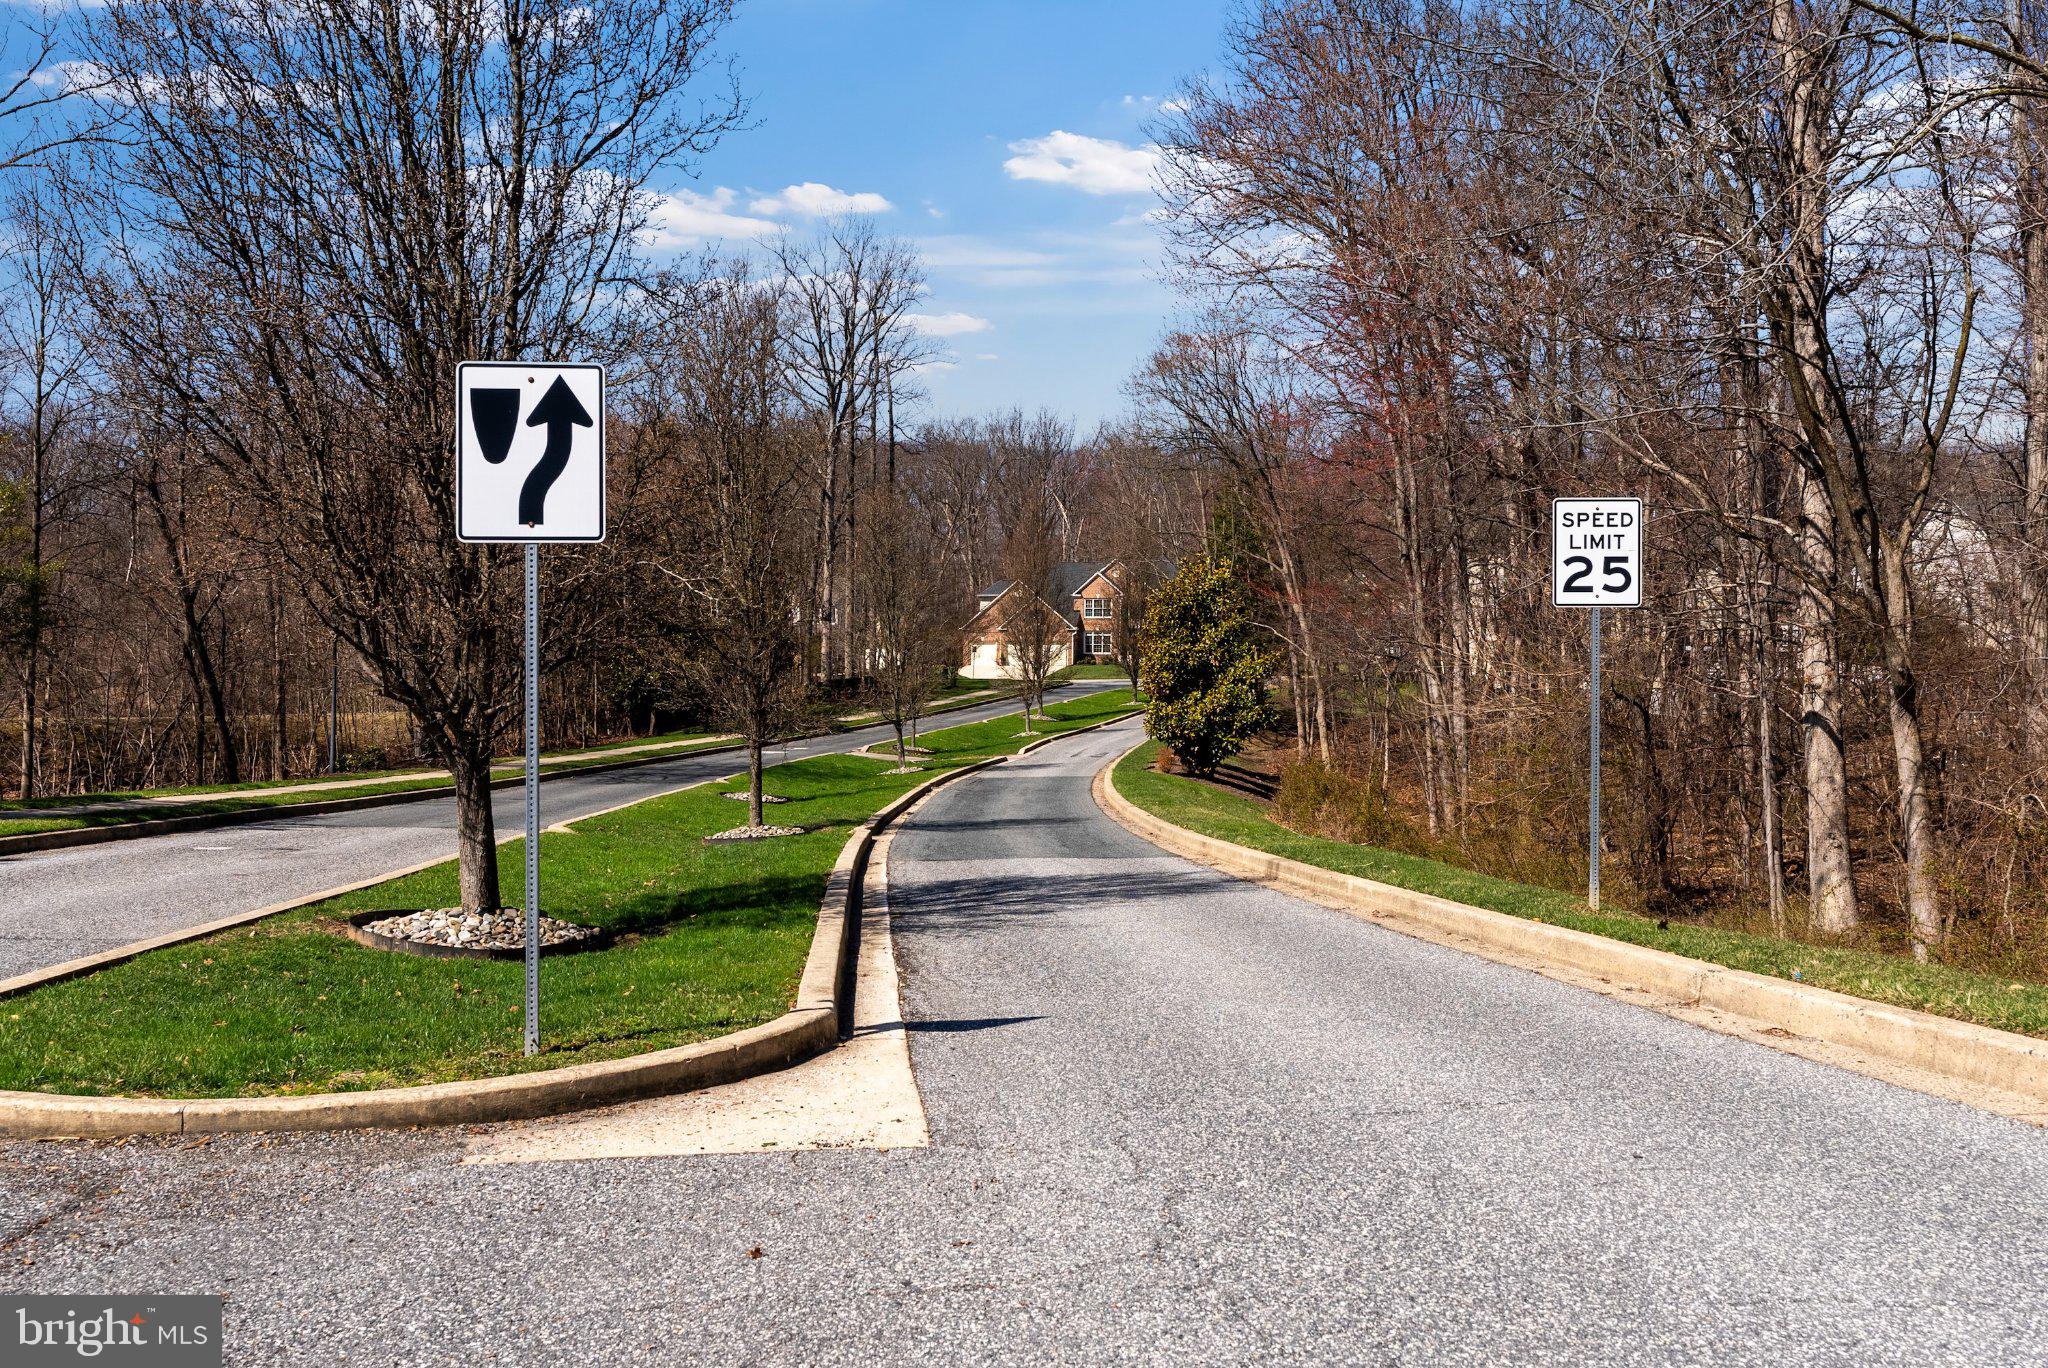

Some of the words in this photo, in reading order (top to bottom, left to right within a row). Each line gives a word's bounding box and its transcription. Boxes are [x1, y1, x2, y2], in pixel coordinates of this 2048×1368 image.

[1562, 512, 1634, 528] SPEED
[1569, 534, 1625, 549] LIMIT
[1562, 555, 1632, 593] 25
